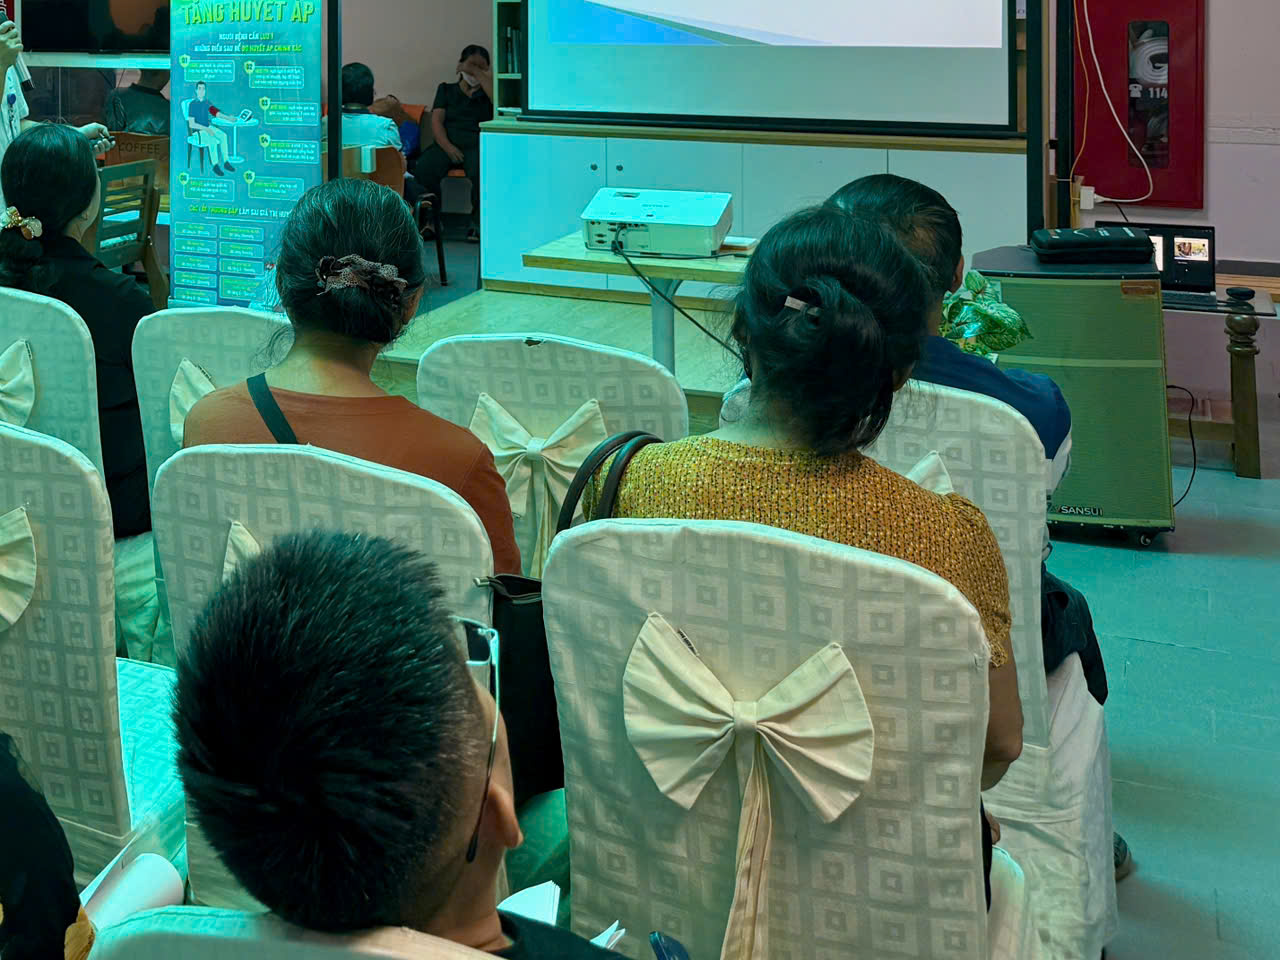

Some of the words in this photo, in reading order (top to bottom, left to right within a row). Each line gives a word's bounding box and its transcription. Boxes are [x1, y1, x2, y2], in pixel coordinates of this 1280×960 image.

[182, 0, 225, 25] TĂNG
[118, 142, 161, 155] COFFEE
[1061, 505, 1104, 517] SANSUI
